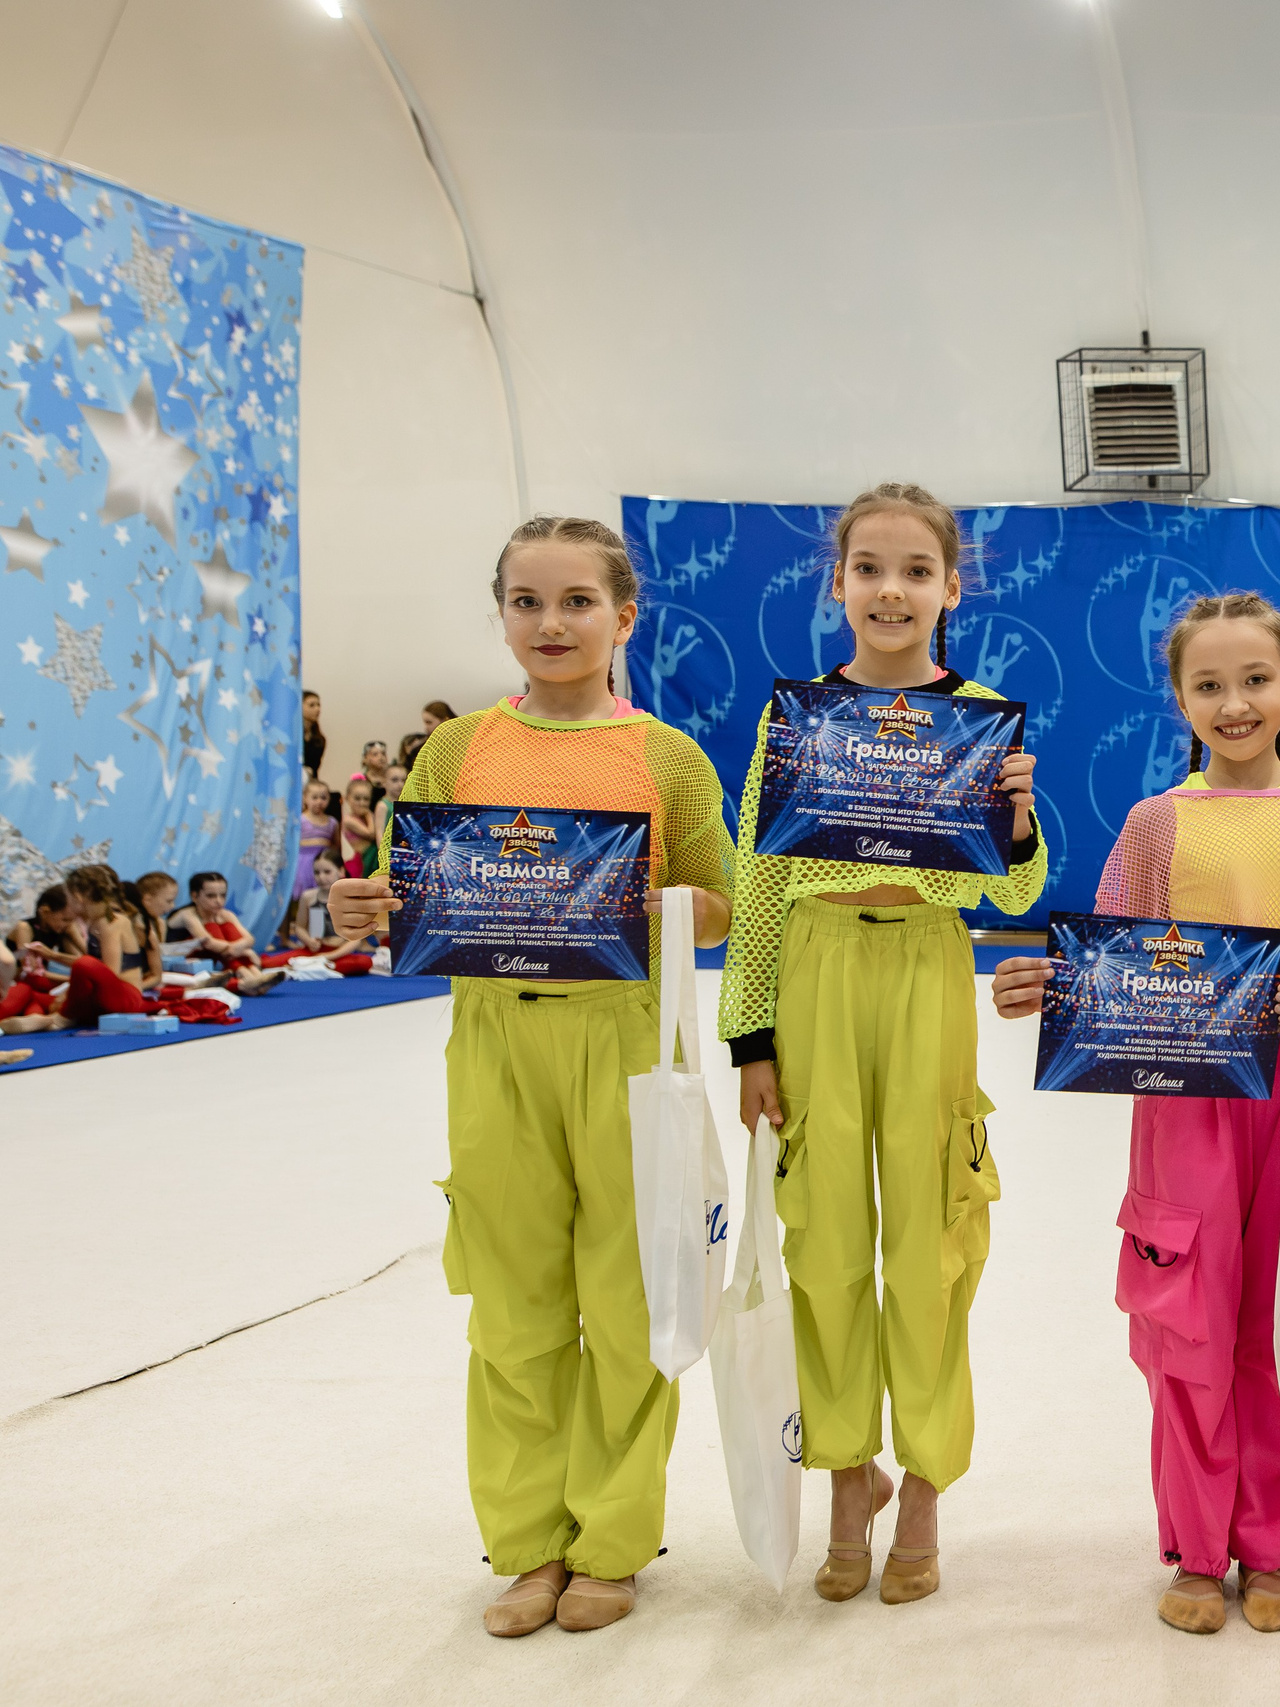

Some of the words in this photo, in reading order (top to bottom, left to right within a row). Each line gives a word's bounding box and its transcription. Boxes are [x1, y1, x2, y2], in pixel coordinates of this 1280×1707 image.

[866, 706, 935, 727] ФАБРИКА
[845, 735, 944, 770] Грамота
[867, 762, 918, 773] НАГРАЖДАЕТСЯ
[817, 787, 864, 797] ПОКАЗАВШАЯ
[865, 791, 900, 801] РЕЗУЛЬТАТ
[933, 798, 961, 806] БАЛЛОВ
[854, 804, 896, 815] ЕЖЕГОДНОМ
[897, 808, 935, 817] ИТОГОВОМ
[795, 807, 881, 820] ОТЧЕТНО-НОРМАТИВНОМ
[881, 815, 911, 823] ТУРНИРЕ
[912, 818, 962, 828] СПОРТИВНОГО
[963, 822, 985, 830] КЛУБА
[818, 816, 881, 829] ХУДОЖЕСТВЕННОЙ
[882, 823, 929, 833] ГИМНАСТИКИ
[929, 827, 960, 836] «МАГИЯ»
[488, 825, 558, 843] ФАБРИКА
[870, 839, 913, 858] Магия
[471, 856, 571, 885] Грамота
[494, 881, 546, 889] НАГРАЖДАЕТСЯ
[427, 929, 513, 937] ОТЧЕТНО-НОРМАТИВНОМ
[486, 923, 528, 931] ЕЖЕГОДНОМ
[451, 937, 515, 946] ХУДОЖЕСТВЕННОЙ
[1141, 937, 1207, 957] ФАБРИКА
[507, 956, 549, 971] Магия
[1121, 969, 1215, 1000] Грамота
[1142, 995, 1191, 1004] НАГРАЖДАЕТСЯ
[1095, 1022, 1140, 1030] ПОКАЗАВШАЯ
[1141, 1024, 1174, 1032] РЕЗУЛЬТАТ
[1074, 1042, 1156, 1053] ОТЧЕТНО-НОРМАТИВНОМ
[1185, 1048, 1231, 1057] СПОРТИВНОГО
[1130, 1038, 1170, 1046] ЕЖЕГОДНОМ
[1096, 1051, 1156, 1061] ХУДОЖЕСТВЕННОЙ
[1157, 1055, 1201, 1063] ГИМНАСТИКИ
[1146, 1071, 1186, 1088] Магия
